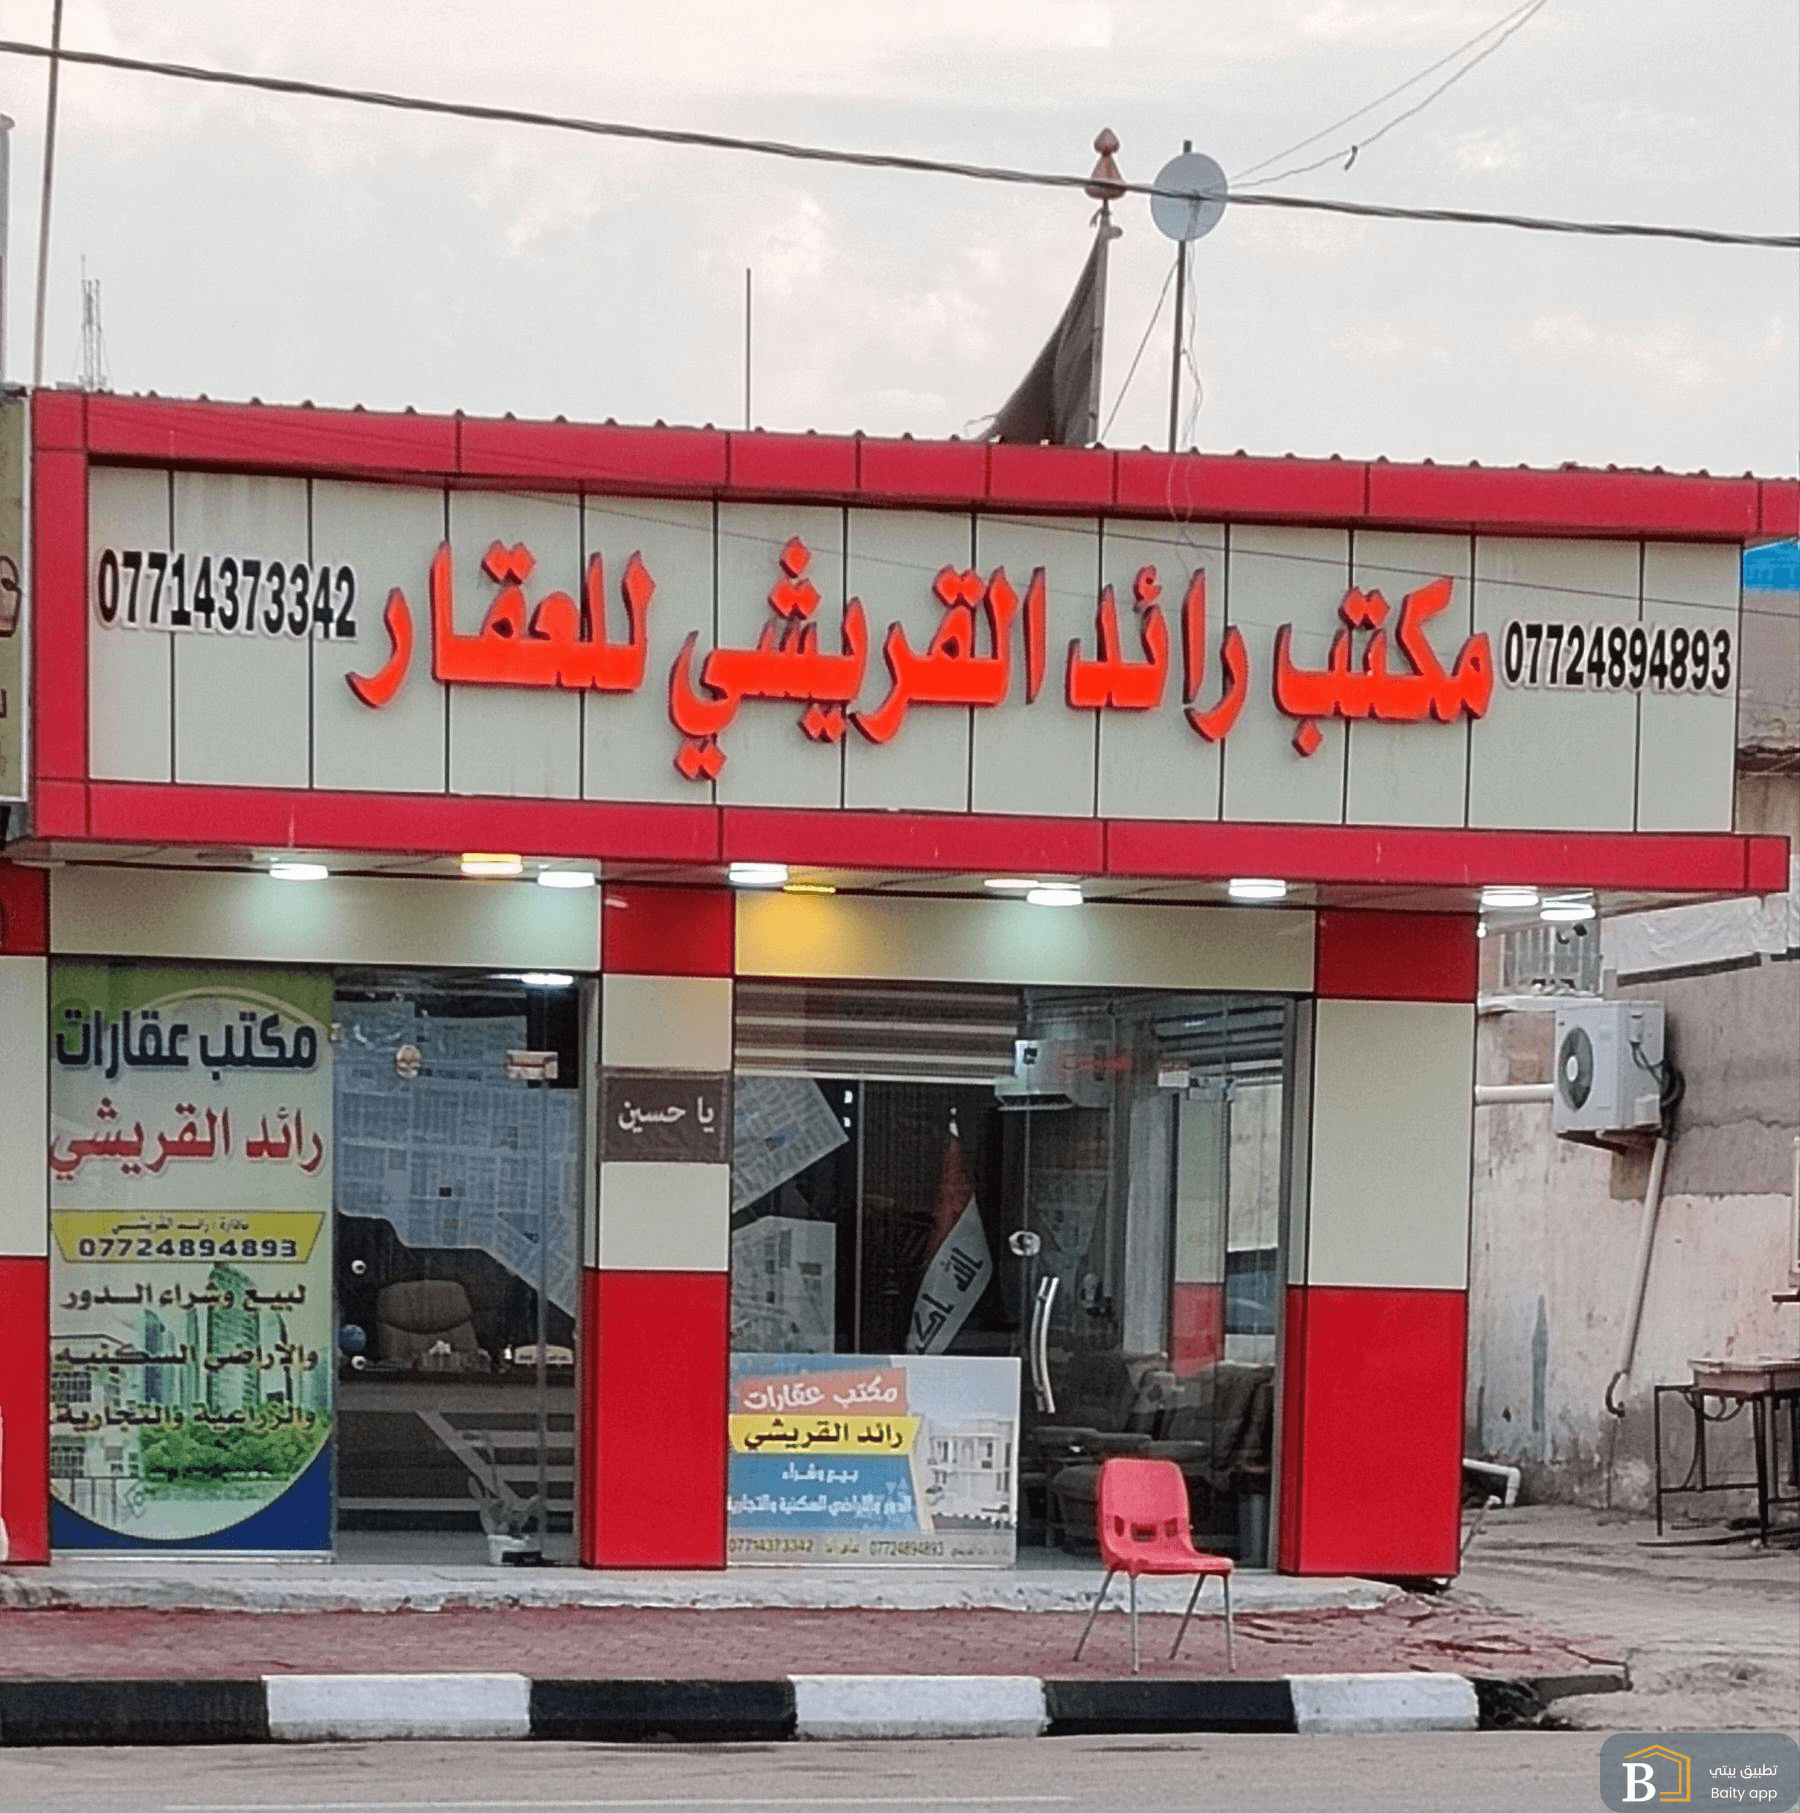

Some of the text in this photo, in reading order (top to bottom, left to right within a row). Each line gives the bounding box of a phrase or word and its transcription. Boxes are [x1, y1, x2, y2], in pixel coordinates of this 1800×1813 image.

[100, 548, 356, 638] 07714373342
[345, 536, 1494, 781] مكتب رائد القريشي للعقار
[1505, 621, 1732, 690] 07724894893
[56, 1009, 317, 1081] مكتب عقارات
[50, 1097, 323, 1181] رائد القريشي
[618, 1096, 714, 1133] يا حسين
[79, 1238, 297, 1257] 07724894893
[60, 1282, 306, 1312] لبيع وشراء الدور
[744, 1376, 898, 1411] مكتب عقارات
[744, 1418, 903, 1449] رائد القريشي
